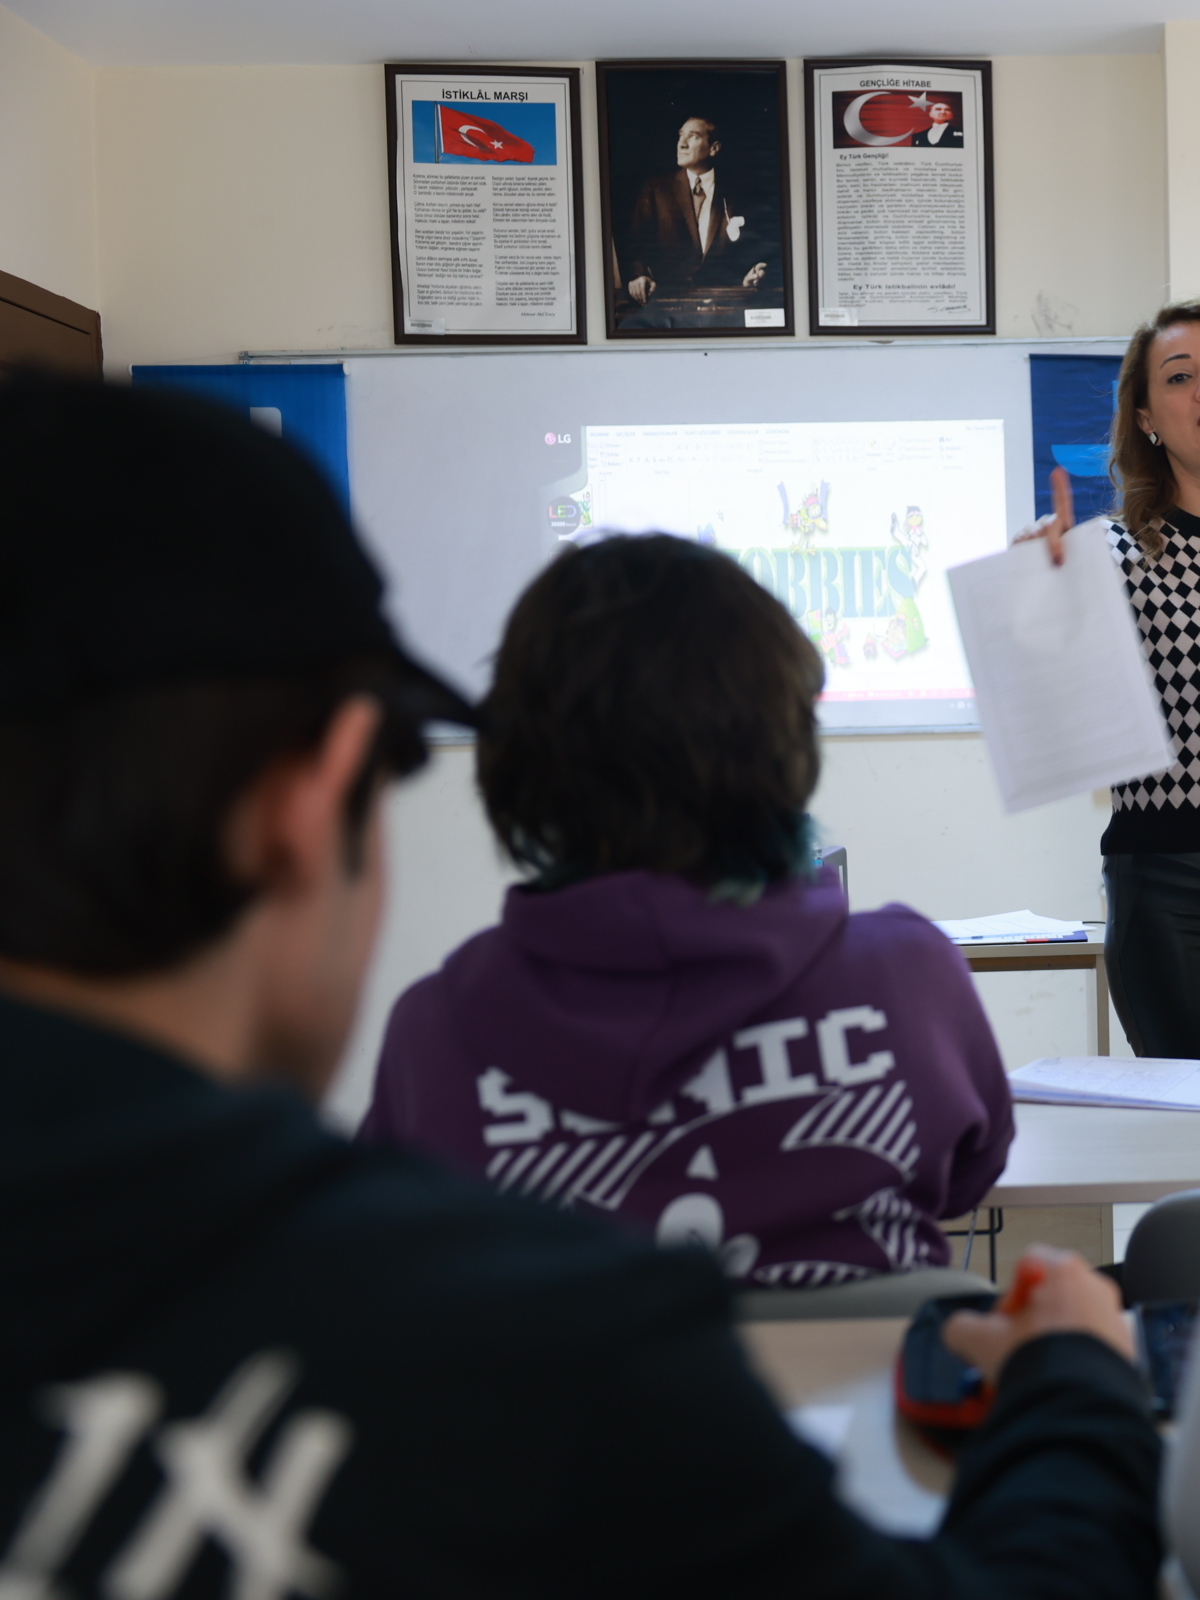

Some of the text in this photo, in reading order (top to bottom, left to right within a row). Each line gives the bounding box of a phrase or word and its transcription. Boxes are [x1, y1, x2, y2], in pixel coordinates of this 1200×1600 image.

[859, 79, 932, 88] GENÇLİĞE HİTABE
[441, 88, 529, 102] İSTİKLÂL MARŞI
[557, 434, 572, 444] LG
[549, 505, 577, 518] LED
[722, 546, 916, 618] OBBIES
[476, 1005, 896, 1147] SIC
